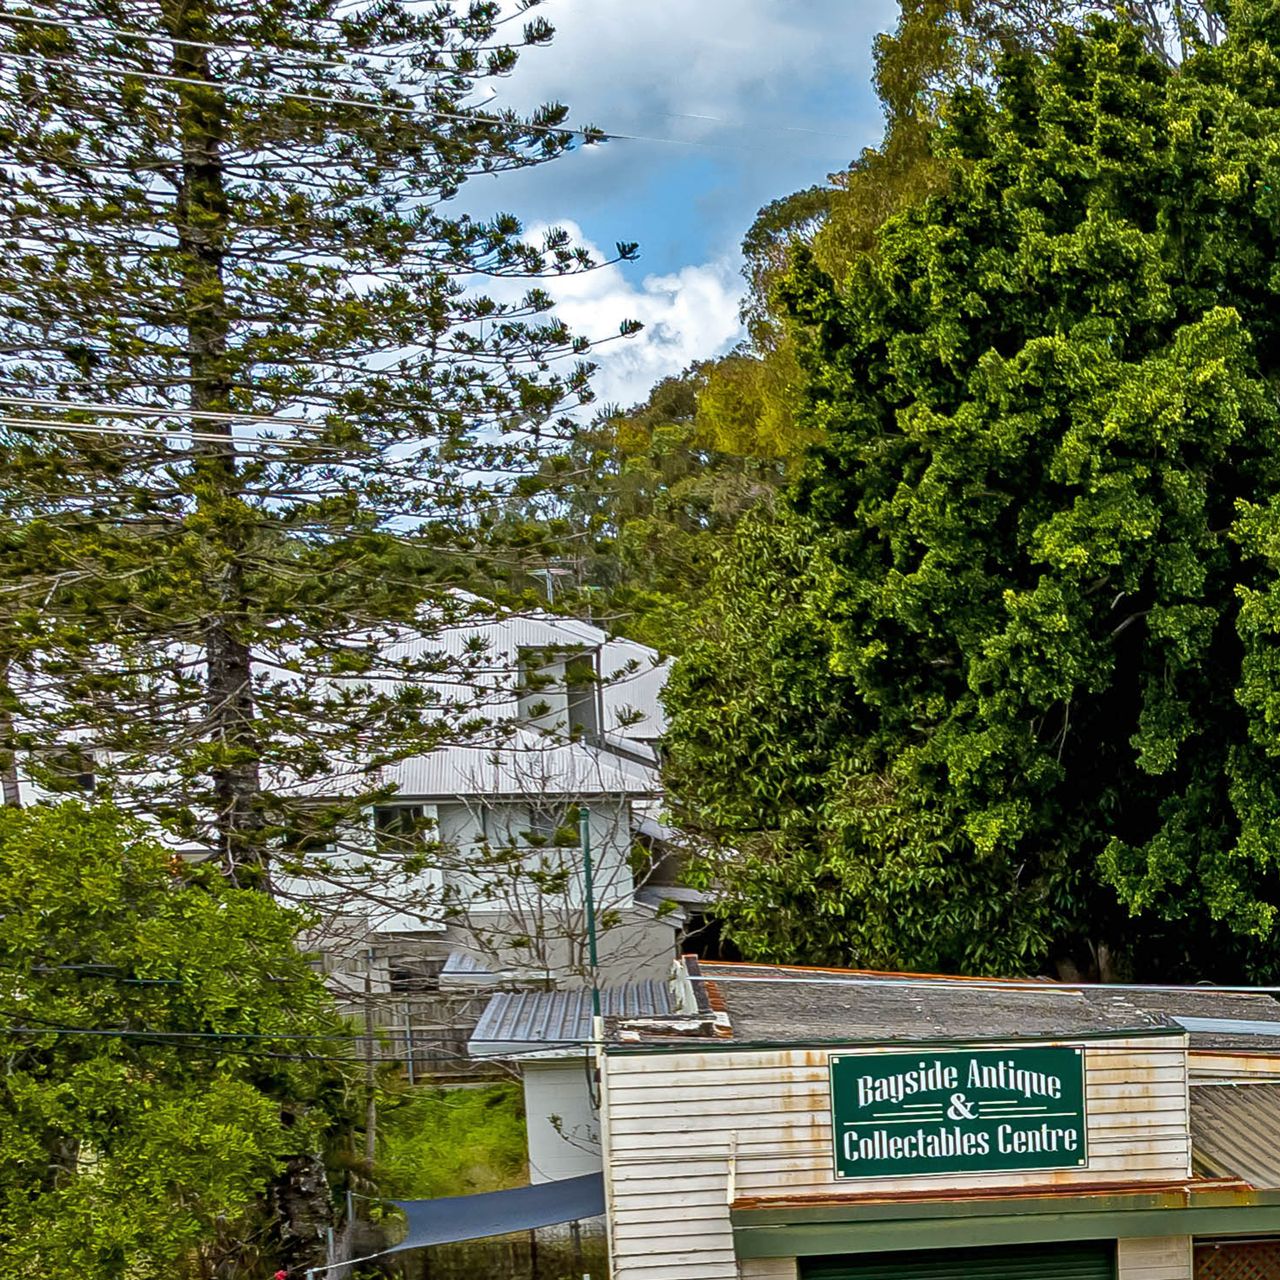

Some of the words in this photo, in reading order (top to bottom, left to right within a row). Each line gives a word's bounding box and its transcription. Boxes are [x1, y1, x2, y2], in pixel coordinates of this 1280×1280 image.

[857, 1060, 958, 1109] Bayside
[967, 1058, 1061, 1099] Antique
[947, 1092, 979, 1121] &
[843, 1126, 989, 1161] Collectables
[997, 1123, 1078, 1154] Centre
